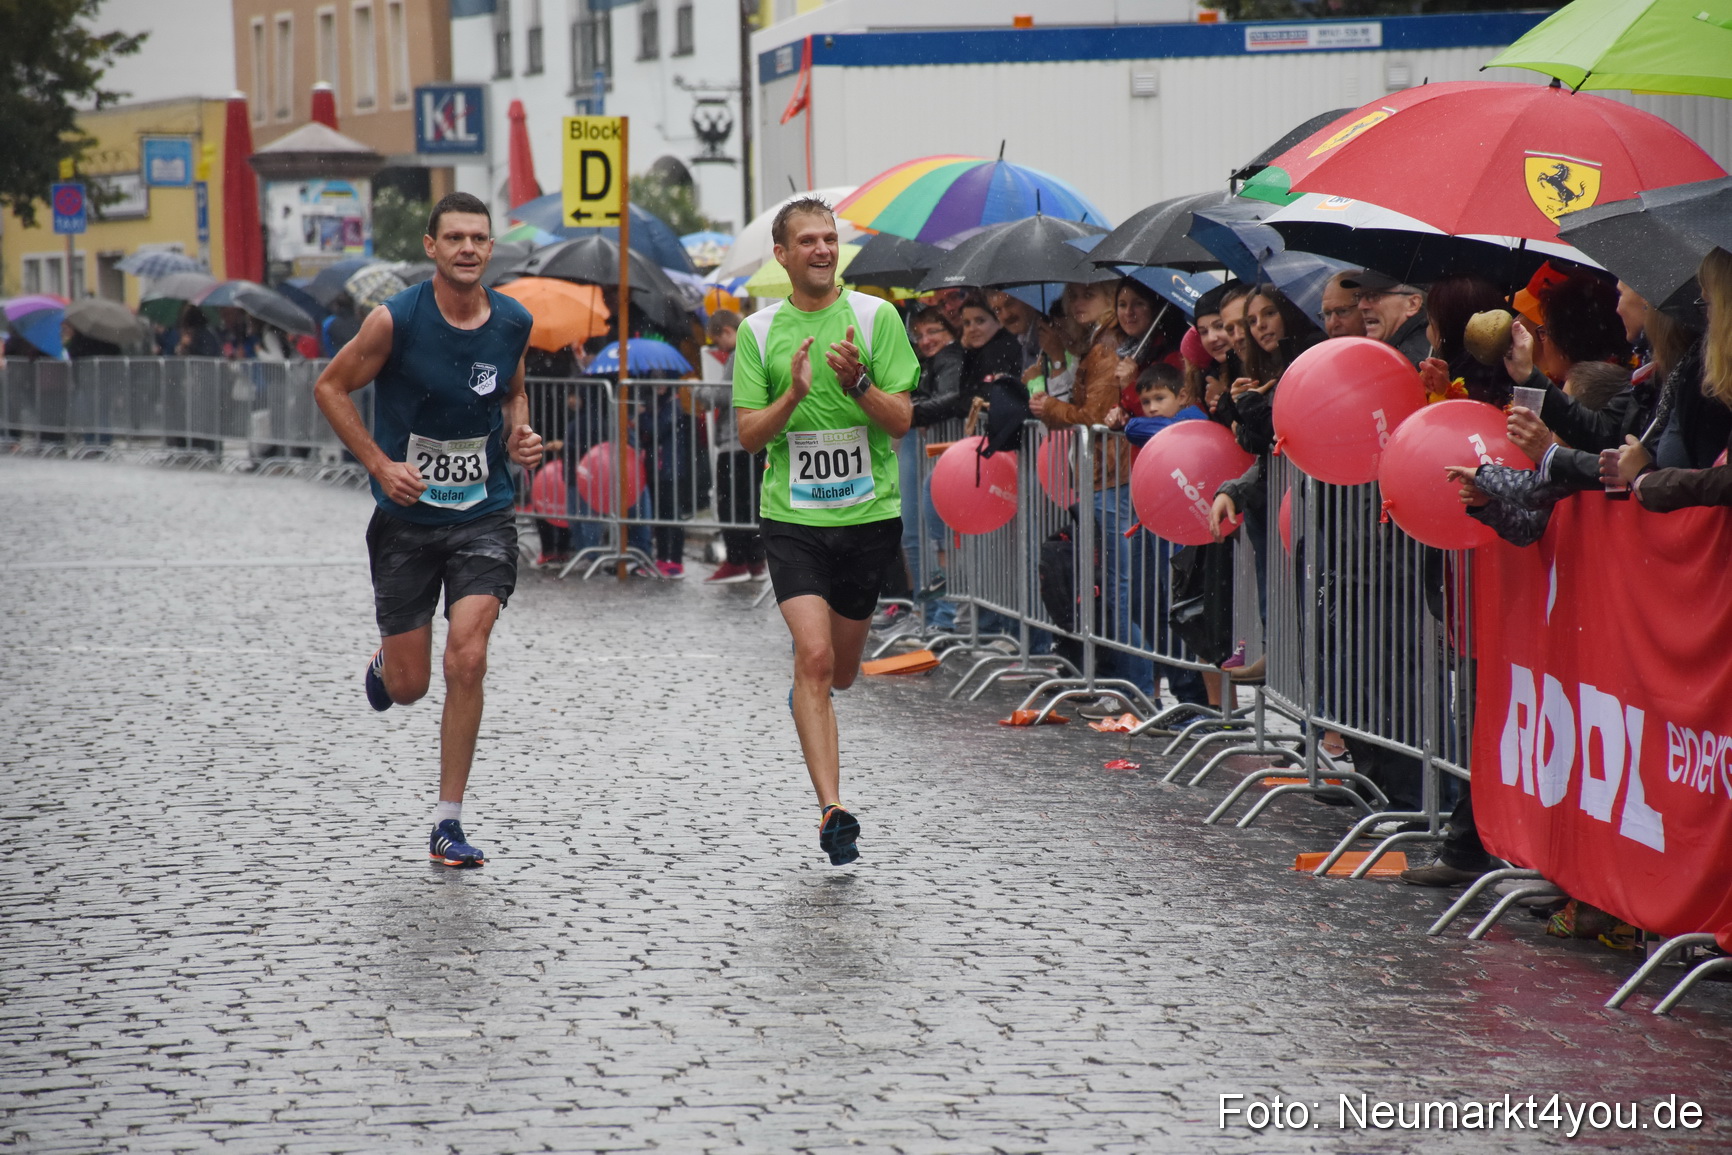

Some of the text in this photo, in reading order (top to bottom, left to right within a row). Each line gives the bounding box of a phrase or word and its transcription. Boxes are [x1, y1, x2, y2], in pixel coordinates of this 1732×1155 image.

[423, 91, 478, 141] KL
[570, 120, 621, 140] Block
[580, 149, 612, 201] D
[823, 428, 861, 442] BOCK
[416, 451, 483, 483] 2833
[798, 445, 863, 480] 2001
[430, 488, 464, 501] Stefan
[811, 483, 855, 499] Michael
